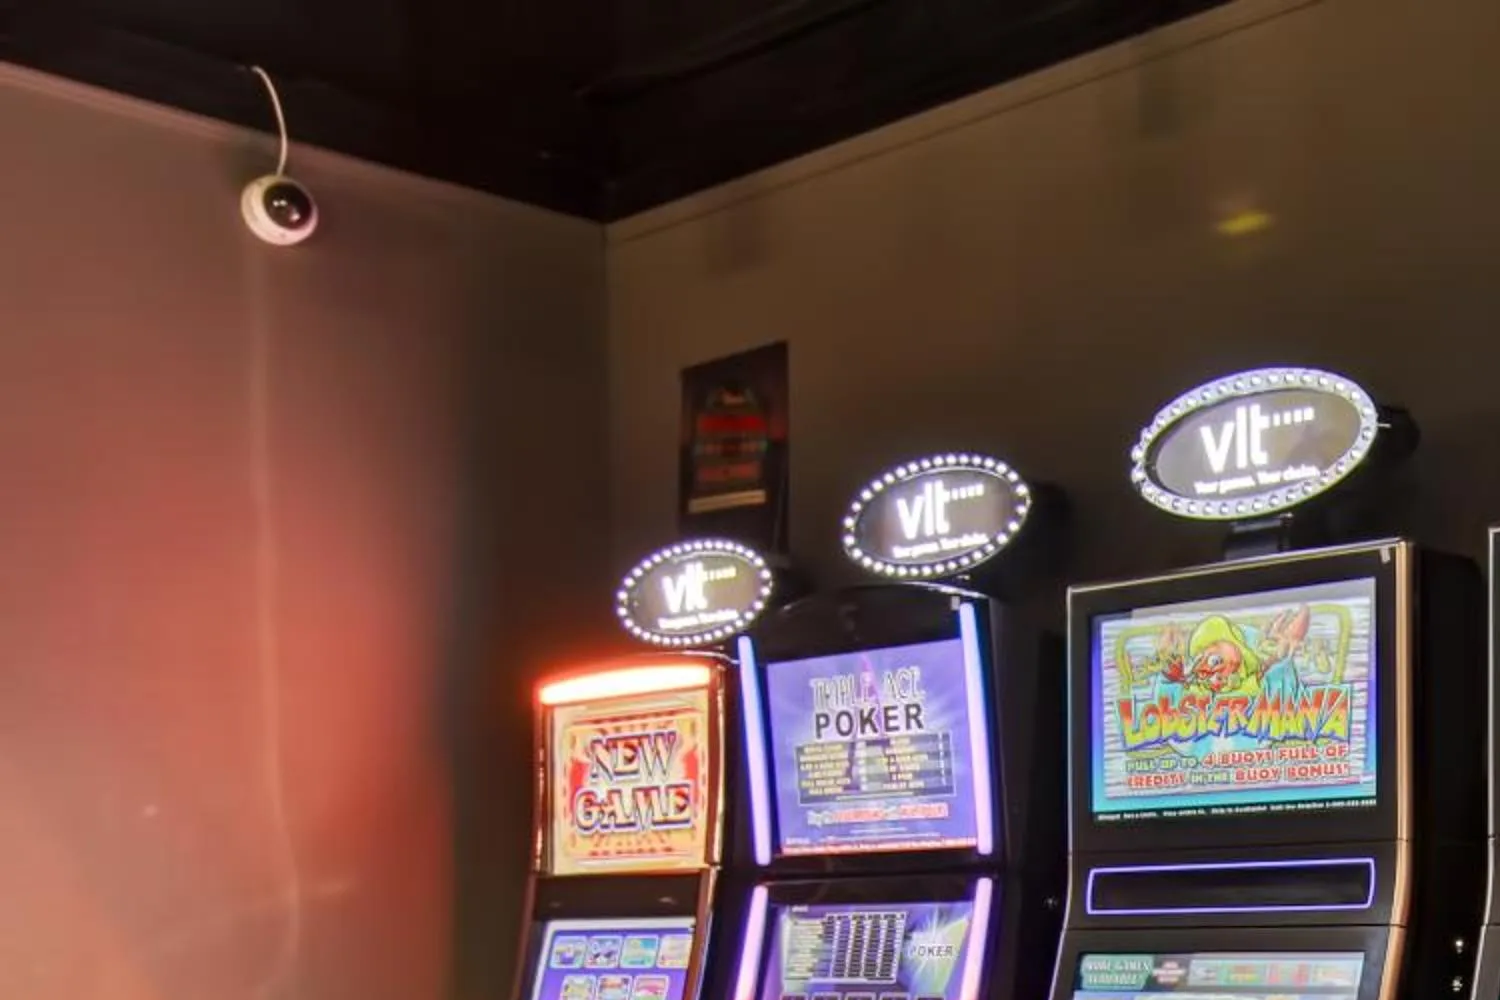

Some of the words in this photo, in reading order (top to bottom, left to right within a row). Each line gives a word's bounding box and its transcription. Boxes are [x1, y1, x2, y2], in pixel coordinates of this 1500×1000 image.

[1200, 404, 1271, 474] vlt
[897, 479, 951, 540] vlt
[661, 562, 709, 613] vlt
[814, 702, 925, 739] POKER
[590, 729, 678, 783] NEW
[1234, 767, 1282, 784] BUOY
[1278, 747, 1319, 762] FULL
[1325, 744, 1348, 759] OF
[574, 782, 694, 833] GAME
